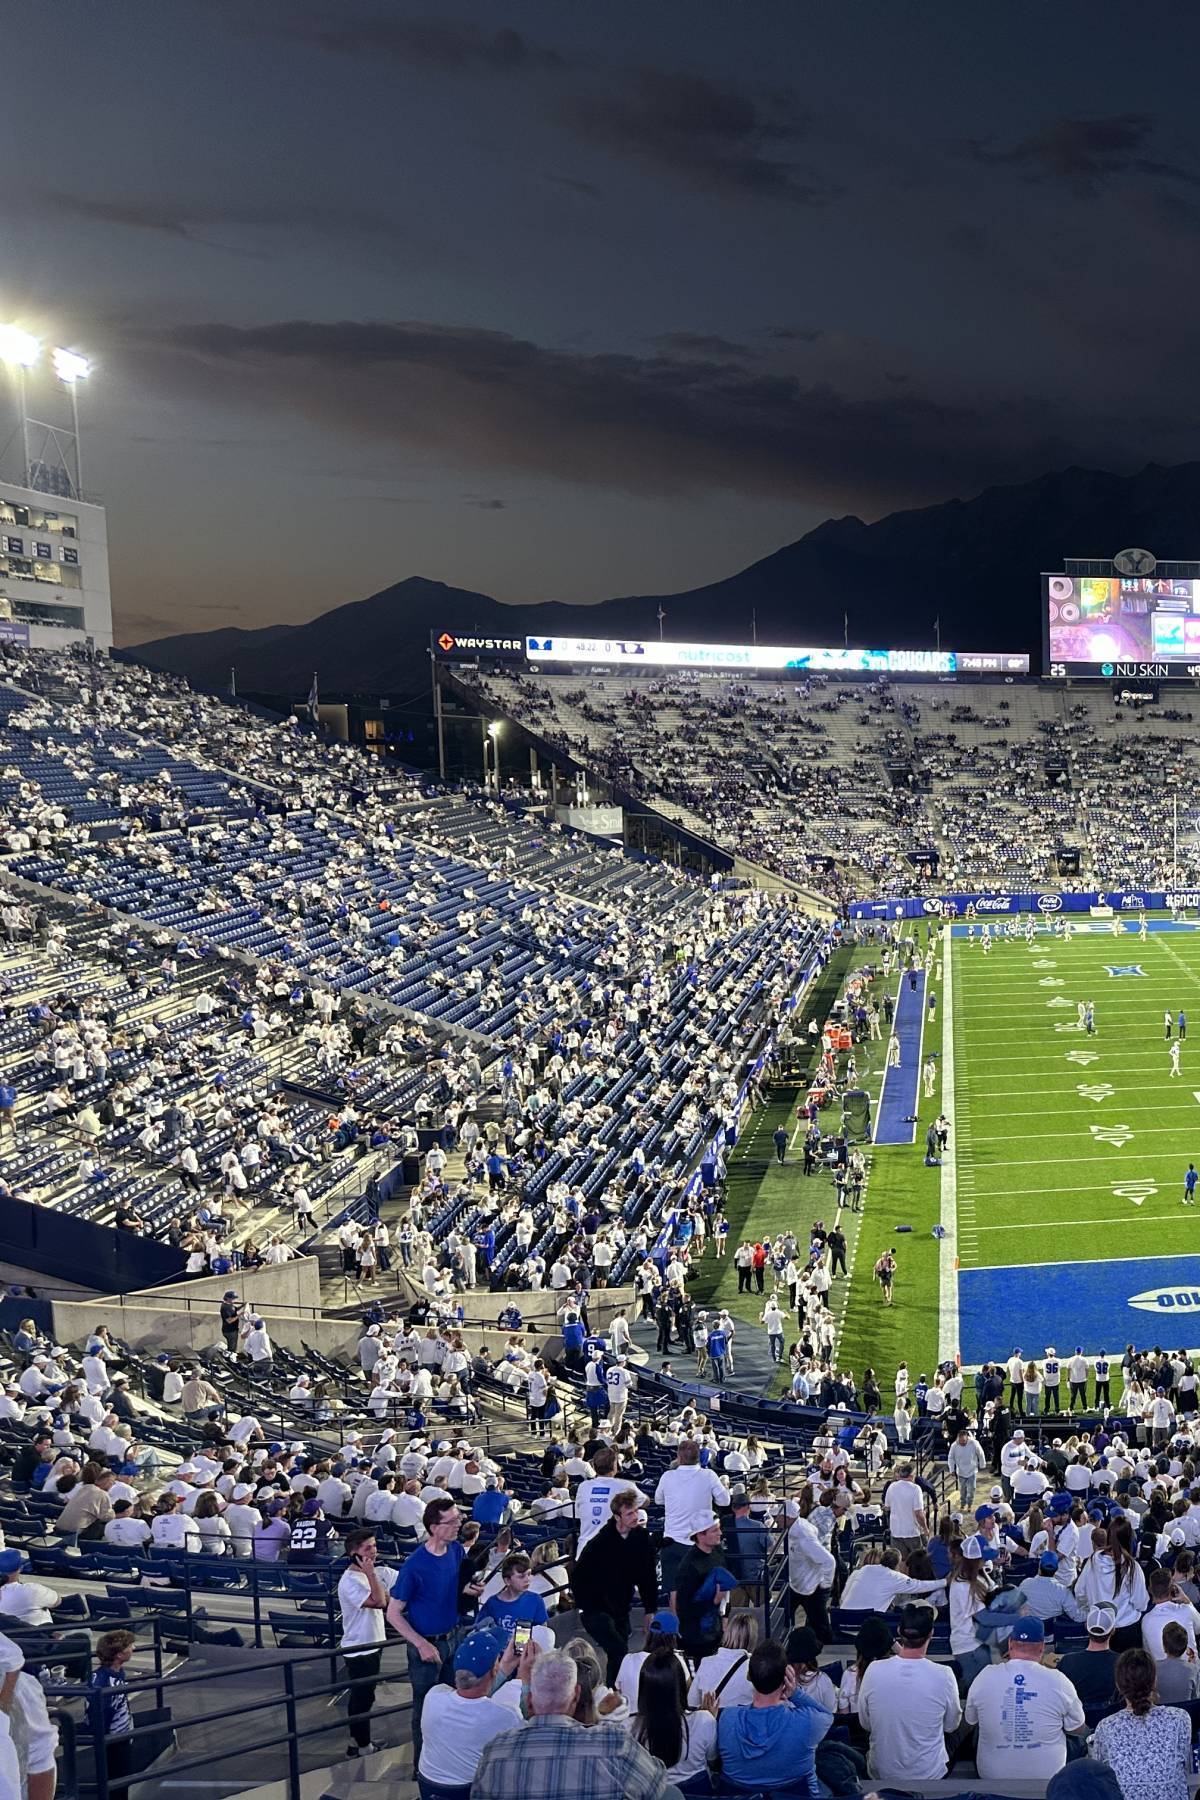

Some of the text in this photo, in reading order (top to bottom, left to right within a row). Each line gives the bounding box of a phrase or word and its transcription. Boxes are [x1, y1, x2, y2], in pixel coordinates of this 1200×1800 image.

[455, 637, 522, 650] WAYSTAR
[678, 649, 750, 663] nutricost
[1050, 664, 1066, 676] 25
[1116, 664, 1169, 677] NU SKIN
[1076, 1082, 1115, 1098] 30
[1090, 1124, 1135, 1142] 20
[1111, 1178, 1158, 1198] 10
[1045, 1362, 1059, 1374] 96
[291, 1528, 317, 1549] 22
